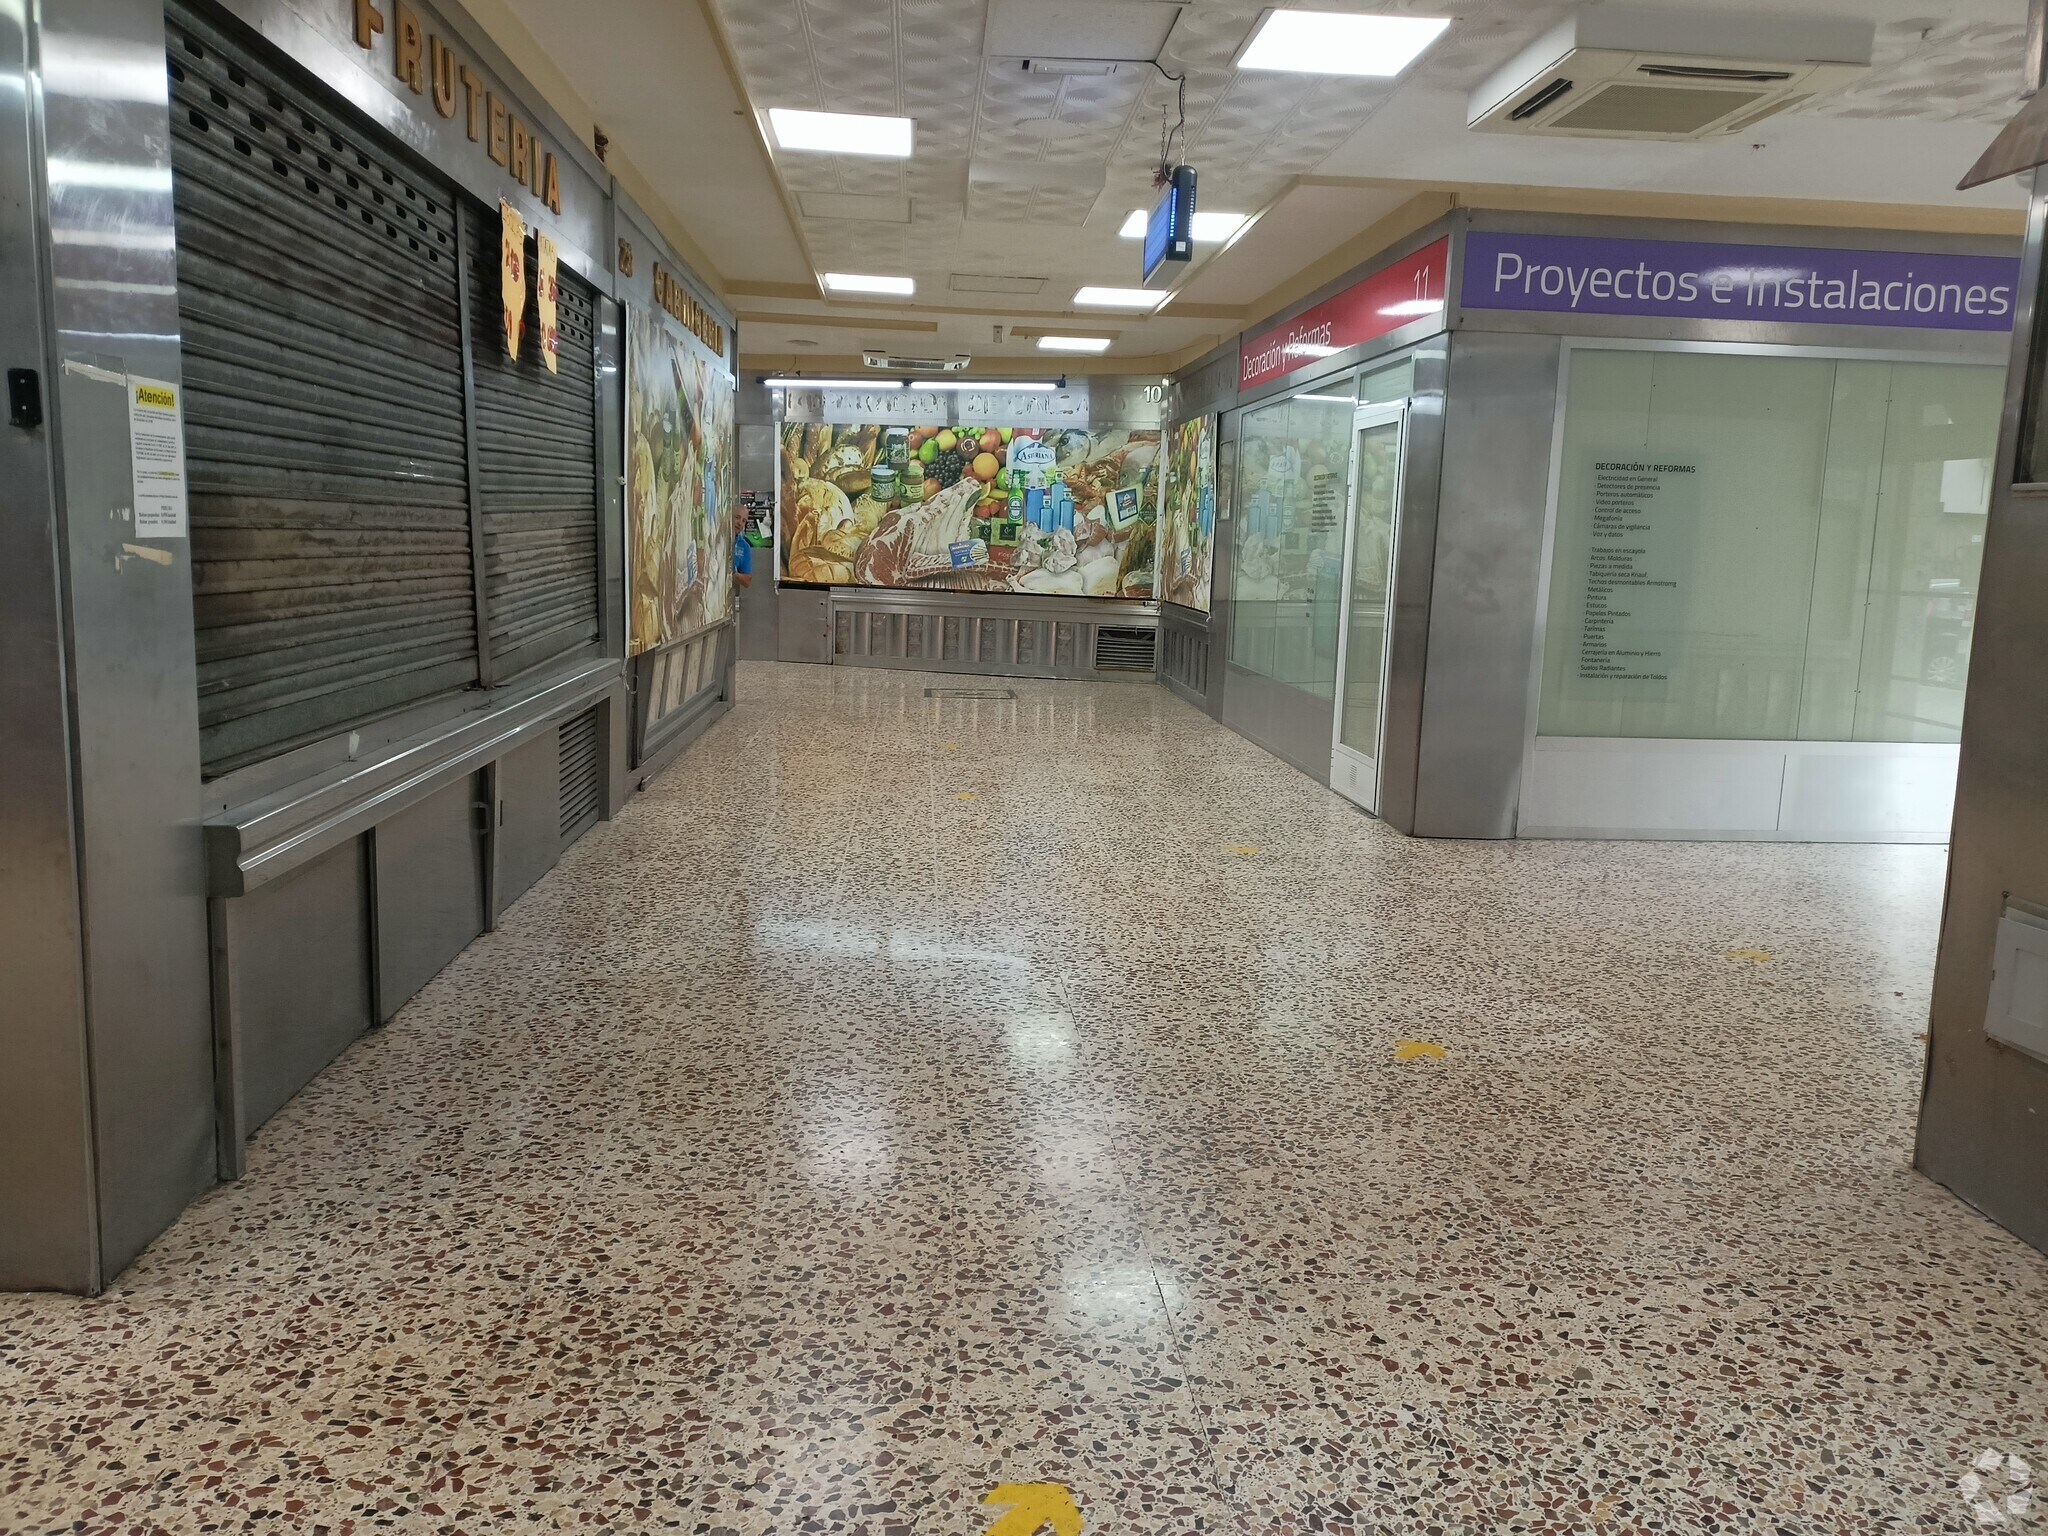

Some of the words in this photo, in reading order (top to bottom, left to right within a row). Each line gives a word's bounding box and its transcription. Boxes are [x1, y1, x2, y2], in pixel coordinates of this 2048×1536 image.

[1413, 265, 1430, 302] 11
[1494, 252, 1699, 308] Proyectos
[1711, 274, 1735, 304] e
[1746, 268, 2010, 316] Instalaciones
[1243, 340, 1281, 381] Decoración
[135, 388, 175, 407] ¡Atención!
[1143, 385, 1162, 403] 10
[1595, 462, 1645, 472] DECORACIÓN
[1653, 465, 1696, 473] REFORMAS
[1598, 474, 1629, 482] Electricidad
[1620, 491, 1654, 499] automáticos
[1611, 499, 1634, 507] porteros
[1591, 546, 1614, 554] Trabajos
[1622, 547, 1646, 555] escayola
[1607, 578, 1646, 586] desmontables
[1585, 610, 1607, 618] Papeles
